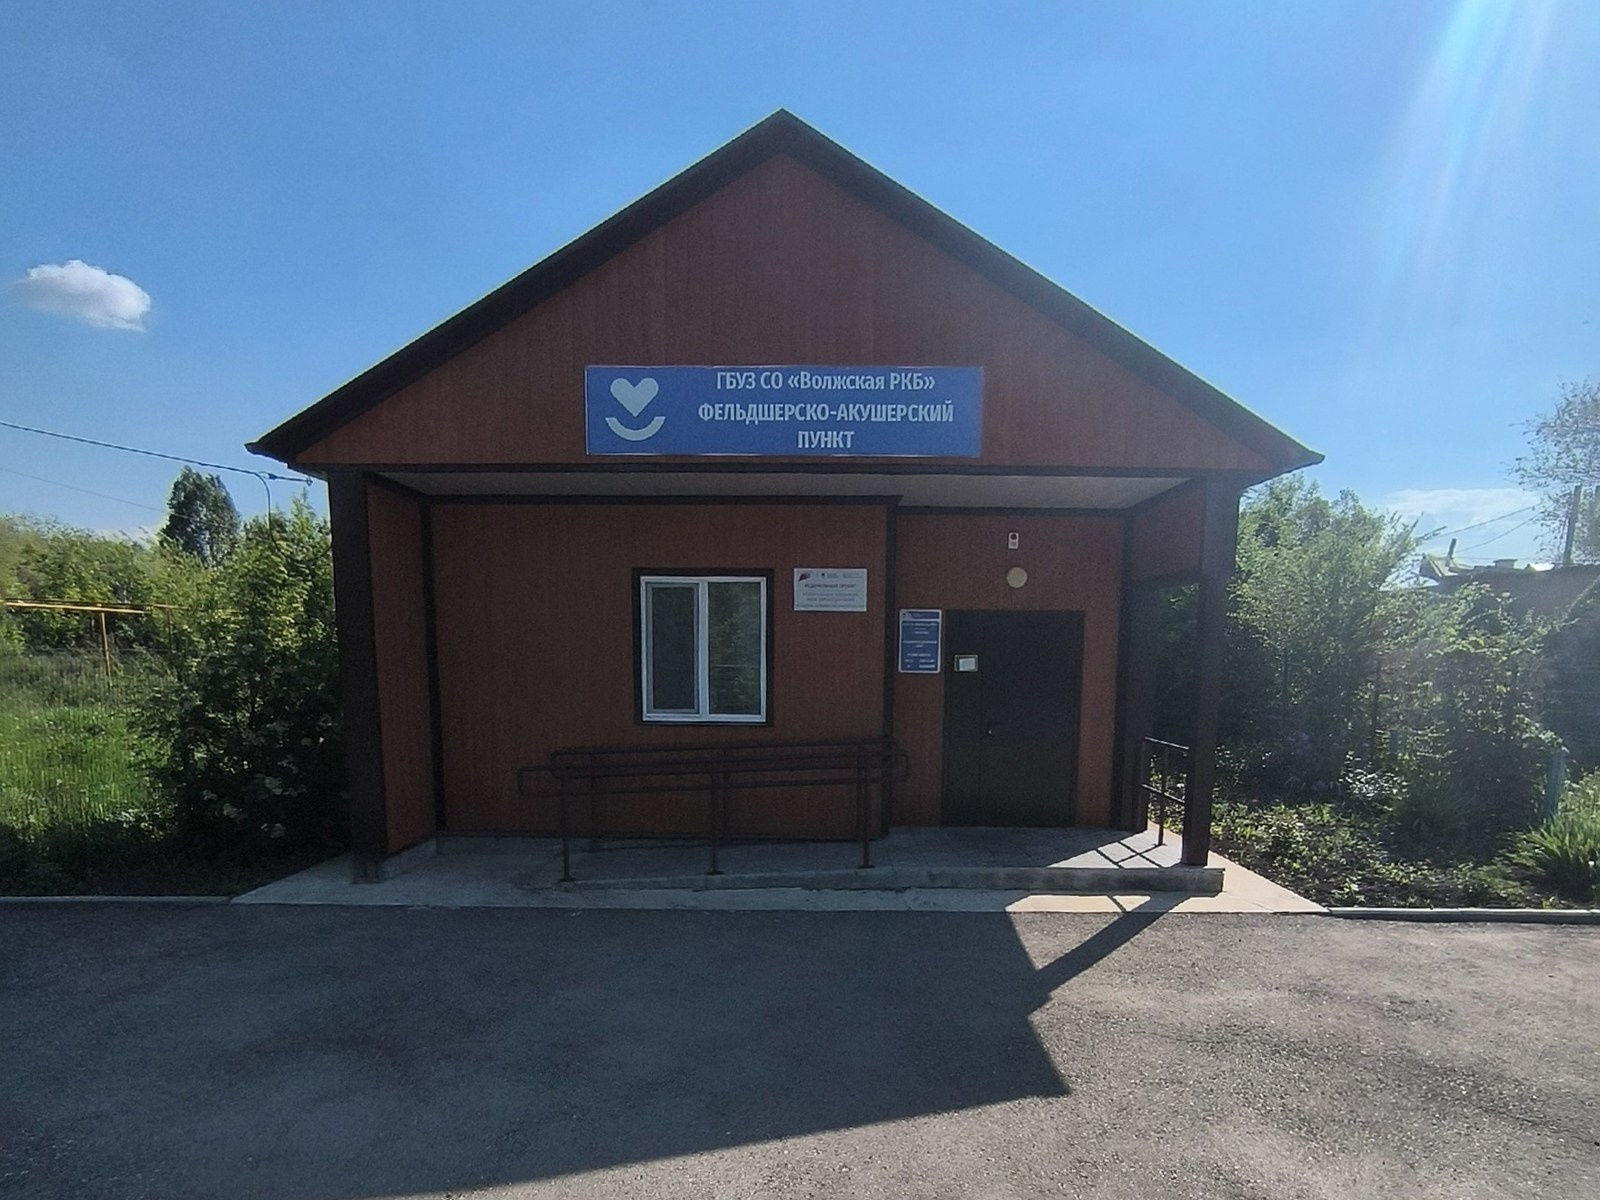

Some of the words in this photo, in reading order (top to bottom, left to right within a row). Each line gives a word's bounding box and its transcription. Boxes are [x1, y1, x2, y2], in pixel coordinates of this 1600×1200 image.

[716, 372, 756, 390] ГБУЗ
[760, 372, 783, 389] СО
[788, 371, 885, 390] «Волжская
[889, 372, 936, 390] РКБ»
[698, 400, 954, 425] ФЕЛЬДШЕРСКО-АКУШЕРСКИЙ
[797, 430, 855, 449] ПУНКТ
